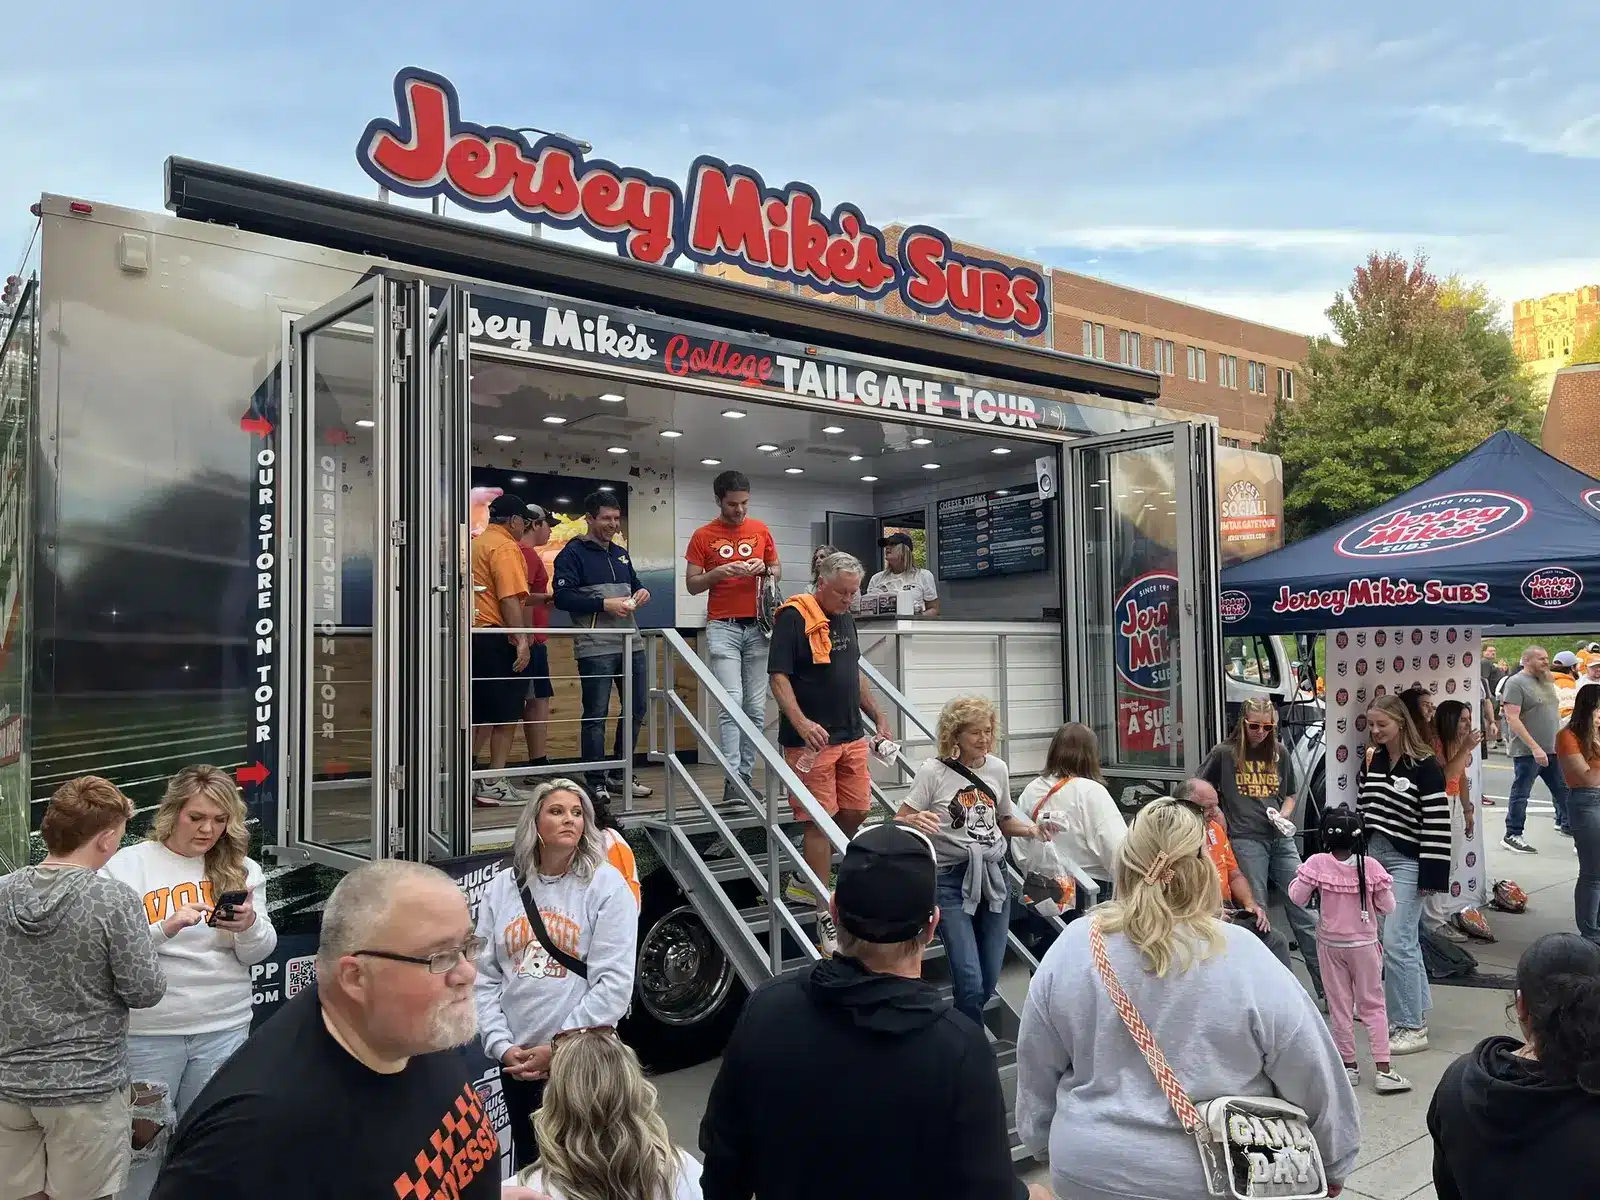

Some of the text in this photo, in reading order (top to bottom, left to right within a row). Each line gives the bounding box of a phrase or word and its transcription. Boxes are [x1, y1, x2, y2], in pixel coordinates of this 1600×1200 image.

[366, 76, 679, 266] Jersey
[689, 166, 898, 292] Mike's
[468, 307, 1038, 428] sey Mike's College TAILGATE TOUR
[940, 498, 962, 509] CHEESE
[963, 494, 988, 506] STEAKS
[1221, 500, 1267, 517] SOCIAL!
[1368, 505, 1511, 532] Jersey
[1354, 520, 1487, 550] Mike's
[1378, 541, 1431, 553] SUBS
[1139, 584, 1170, 598] SINCE 195
[1528, 574, 1575, 588] Jersey
[255, 449, 275, 742] OUR STORE ON TOUR
[1272, 585, 1348, 615] Jersey
[1347, 577, 1424, 606] Mike's
[1120, 599, 1169, 637] Jers
[1128, 714, 1140, 735] A
[1152, 723, 1183, 748] ABO
[1235, 773, 1280, 786] ORANGE
[1247, 785, 1270, 798] ERA
[252, 962, 279, 981] PP
[253, 990, 279, 1005] OM
[1229, 1113, 1312, 1150] GAME
[1249, 1150, 1311, 1184] DAY
